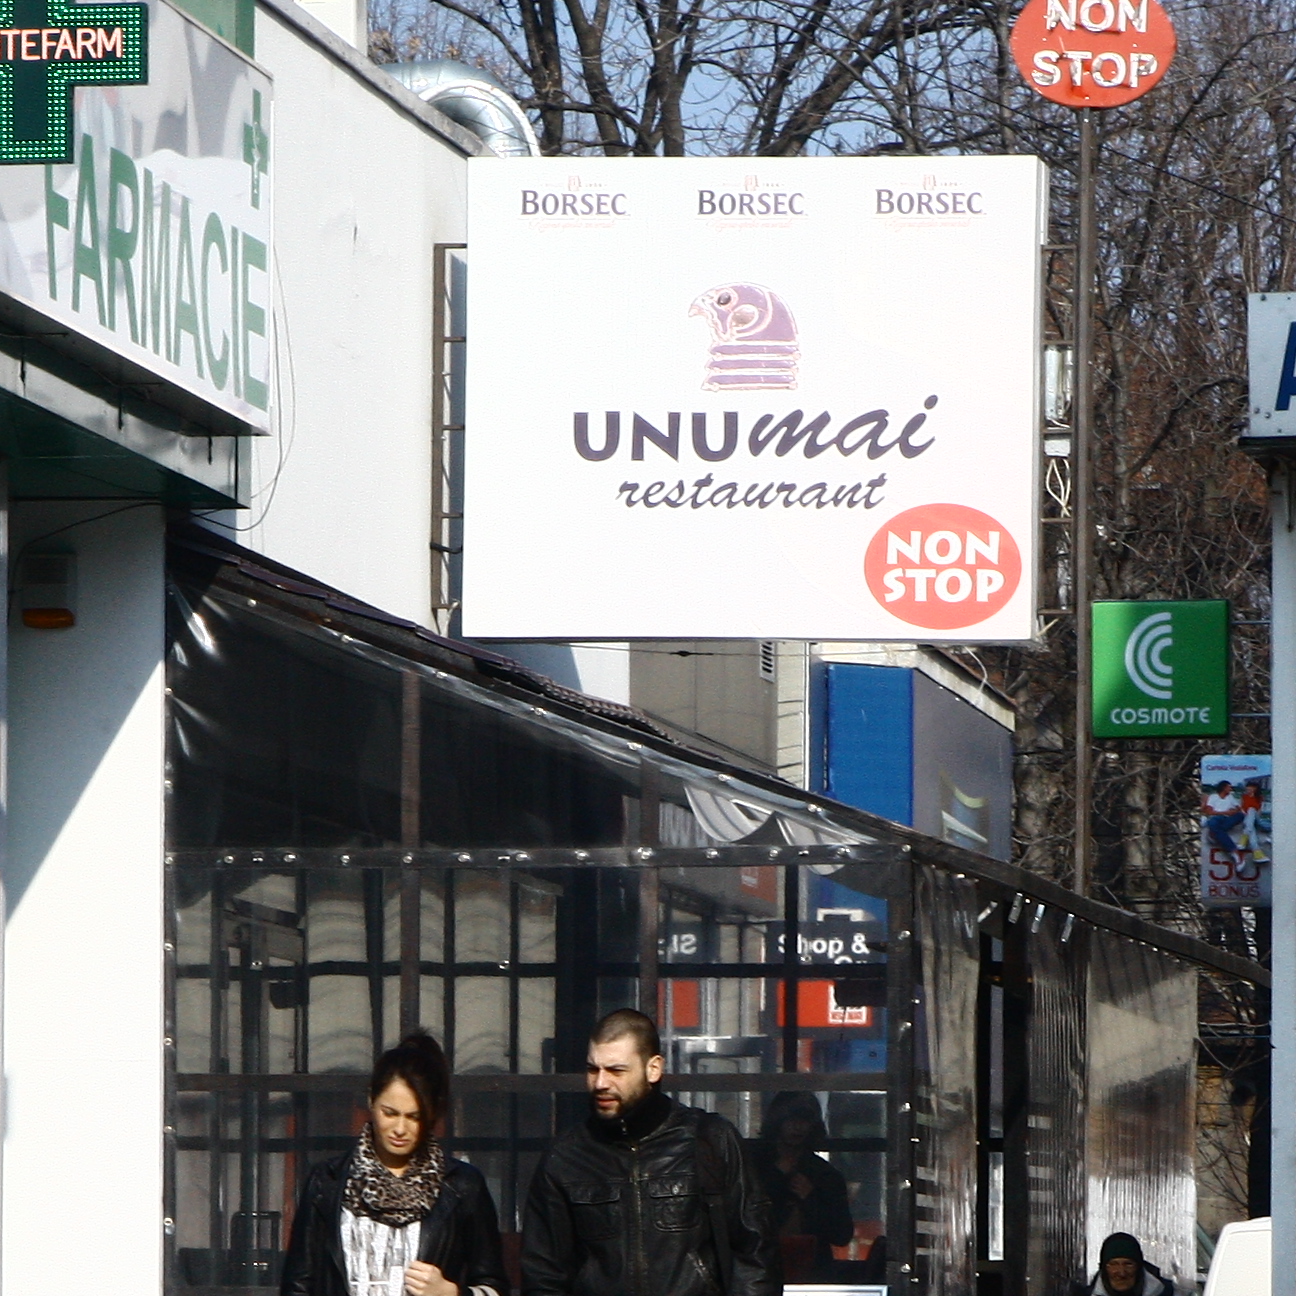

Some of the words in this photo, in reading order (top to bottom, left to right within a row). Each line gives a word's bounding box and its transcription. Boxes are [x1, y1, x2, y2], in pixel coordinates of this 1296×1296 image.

[1043, 0, 1149, 33] NON
[1031, 50, 1158, 88] STOP
[519, 189, 628, 216] BORSEC
[696, 189, 805, 216] BORSEC
[875, 188, 984, 215] BORSEC
[44, 133, 268, 412] FARMACIE
[615, 472, 888, 510] restaurant
[886, 530, 1000, 566] NON
[882, 567, 1005, 604] STOP
[1110, 706, 1211, 725] COSMOTE
[1208, 883, 1261, 899] BONUS
[851, 932, 870, 955] &
